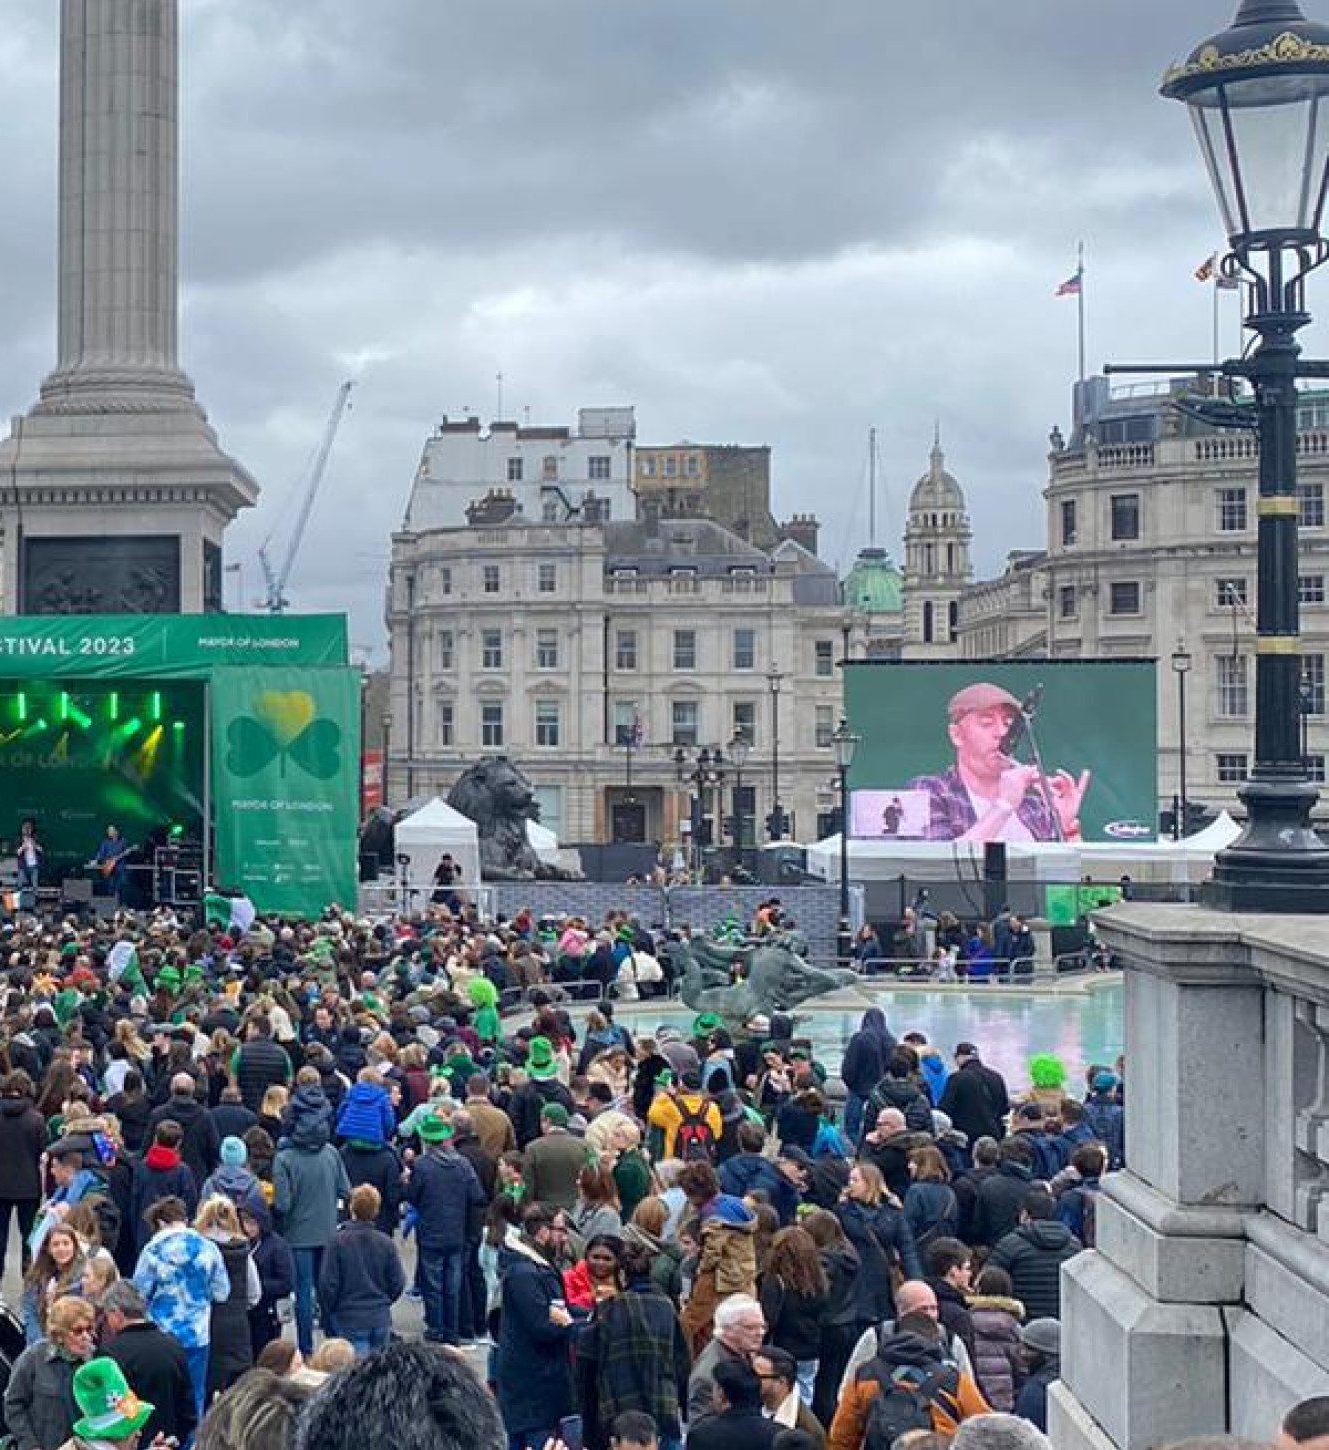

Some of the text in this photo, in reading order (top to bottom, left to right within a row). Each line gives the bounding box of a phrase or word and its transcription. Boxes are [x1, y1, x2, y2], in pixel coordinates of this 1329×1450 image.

[79, 637, 136, 655] 2023
[198, 638, 300, 649] MAYOR OF LONDON
